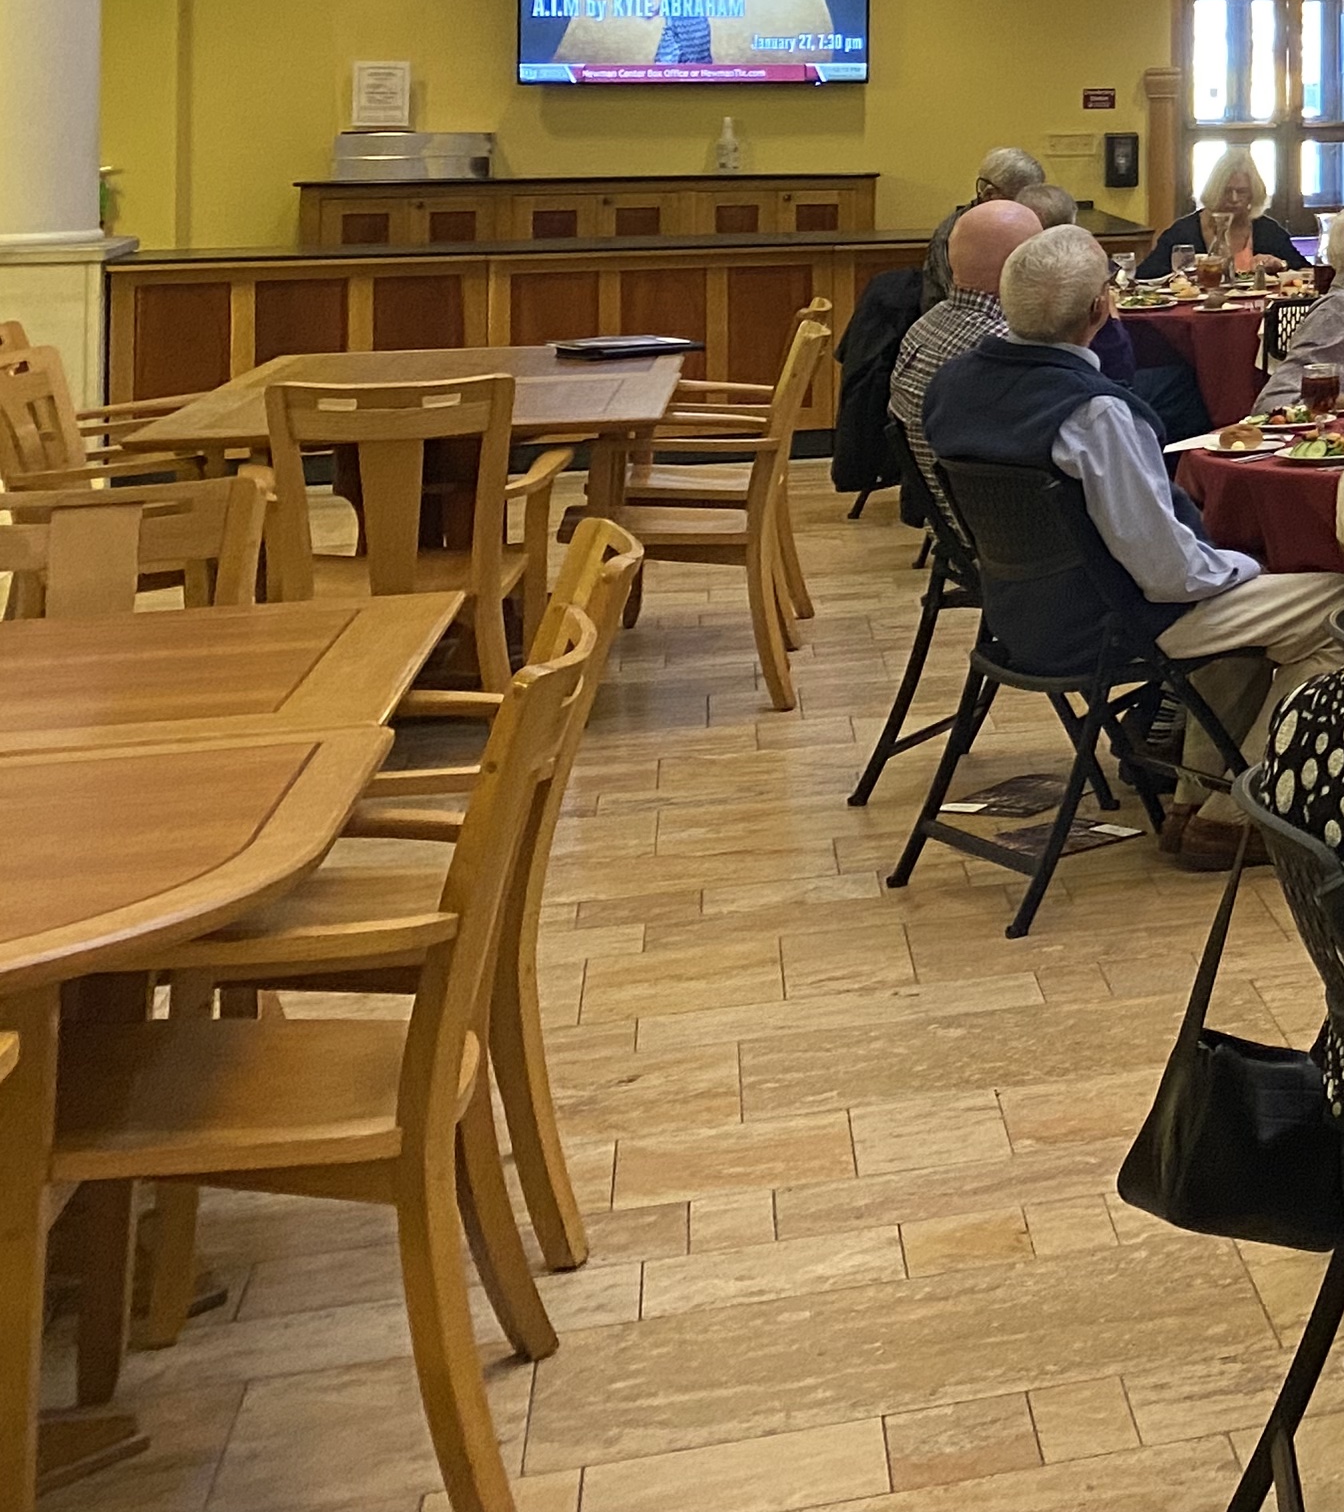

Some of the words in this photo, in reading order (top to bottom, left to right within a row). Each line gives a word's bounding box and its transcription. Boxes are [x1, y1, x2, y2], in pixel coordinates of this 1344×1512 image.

[751, 34, 795, 52] January
[798, 34, 815, 51] 27,
[844, 37, 862, 53] pm
